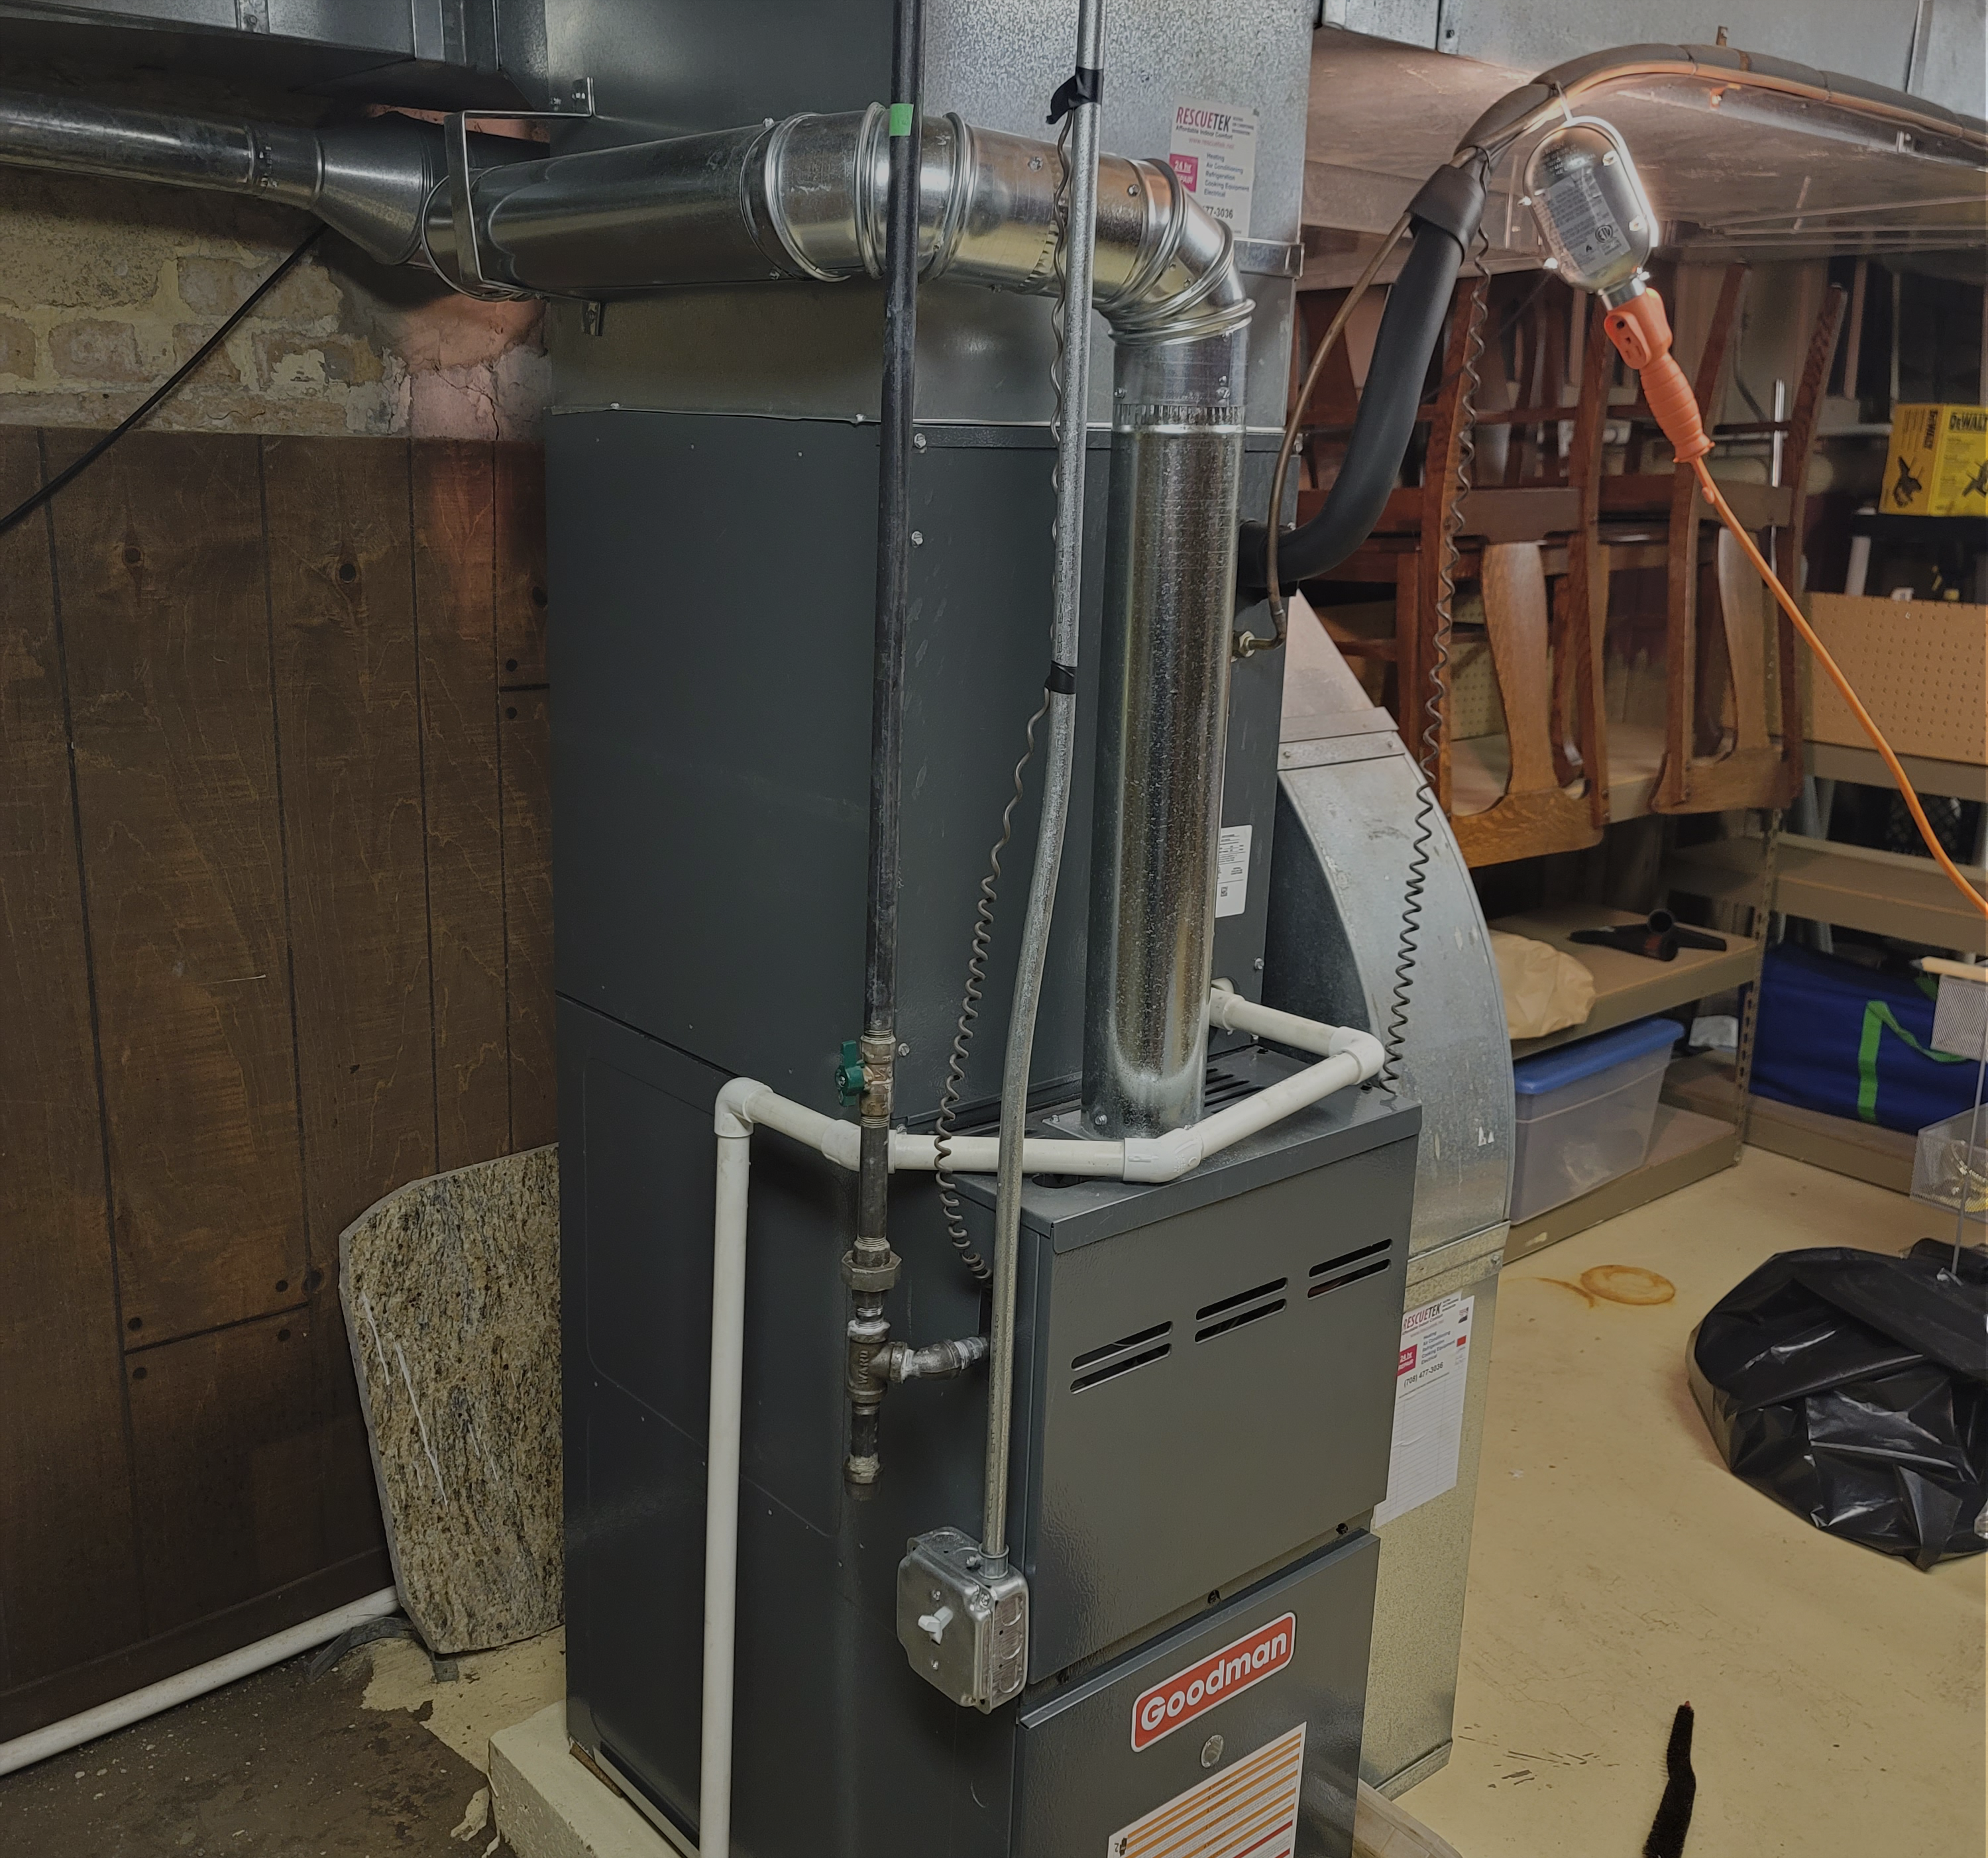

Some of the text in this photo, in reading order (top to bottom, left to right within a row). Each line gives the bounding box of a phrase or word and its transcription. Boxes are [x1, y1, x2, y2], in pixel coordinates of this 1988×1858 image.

[1176, 106, 1231, 133] RESCUETEK
[1176, 125, 1199, 135] Affordable
[1215, 132, 1233, 140] Comfort
[1207, 152, 1225, 163] Heating
[1205, 171, 1235, 181] Refrigeration
[1214, 163, 1244, 175] Conditioning
[1204, 189, 1226, 197] Electrical
[1205, 180, 1250, 192] Cooking Equipment
[1203, 205, 1233, 219] 77-3036
[858, 1350, 869, 1384] WARD
[1404, 1374, 1418, 1388] (708)
[1419, 1362, 1443, 1378] 477-3036
[1141, 1632, 1287, 1731] Goodman
